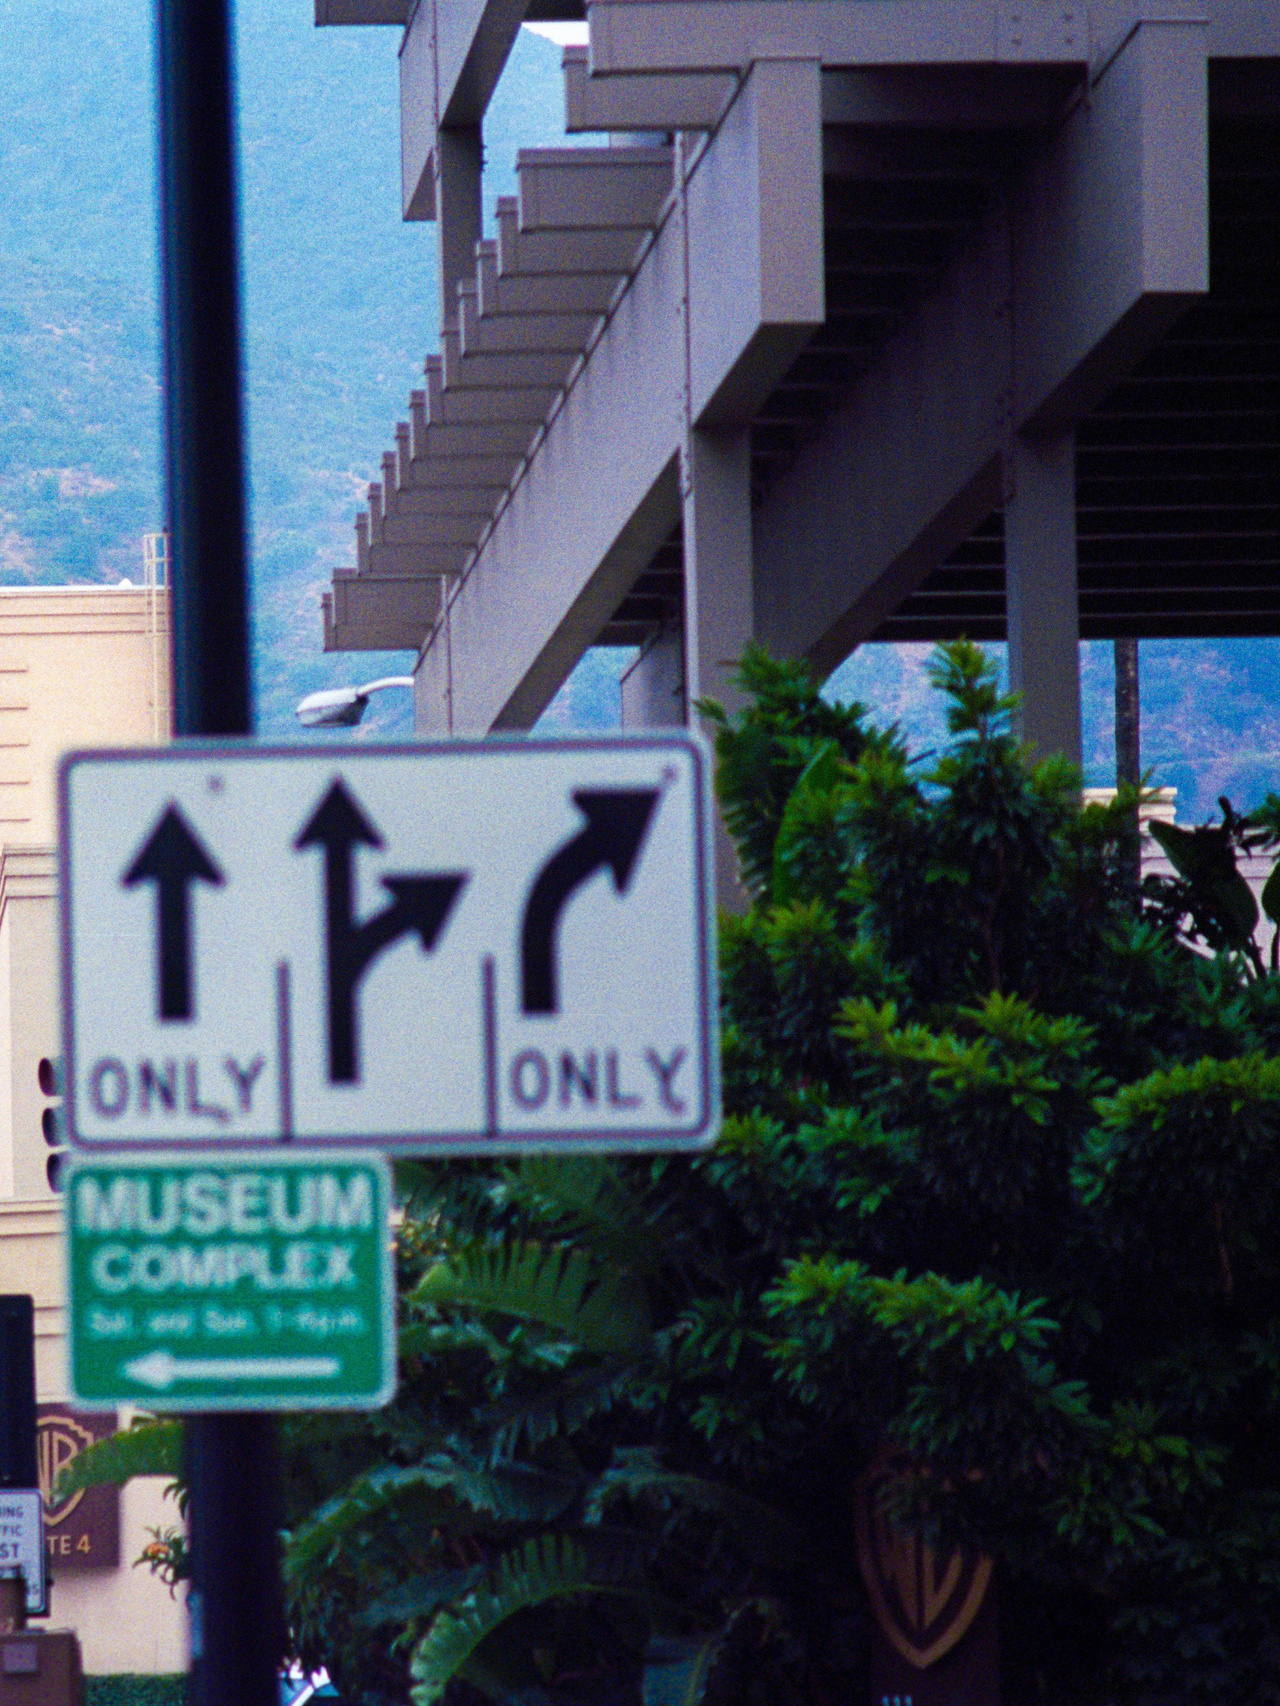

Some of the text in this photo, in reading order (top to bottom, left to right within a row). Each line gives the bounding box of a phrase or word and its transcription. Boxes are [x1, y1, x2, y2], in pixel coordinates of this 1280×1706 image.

[88, 1056, 266, 1122] ONLY
[508, 1045, 687, 1116] ONLY
[77, 1174, 374, 1235] MUSEUM
[91, 1244, 356, 1293] COMPLEX
[47, 1535, 91, 1554] TE 4
